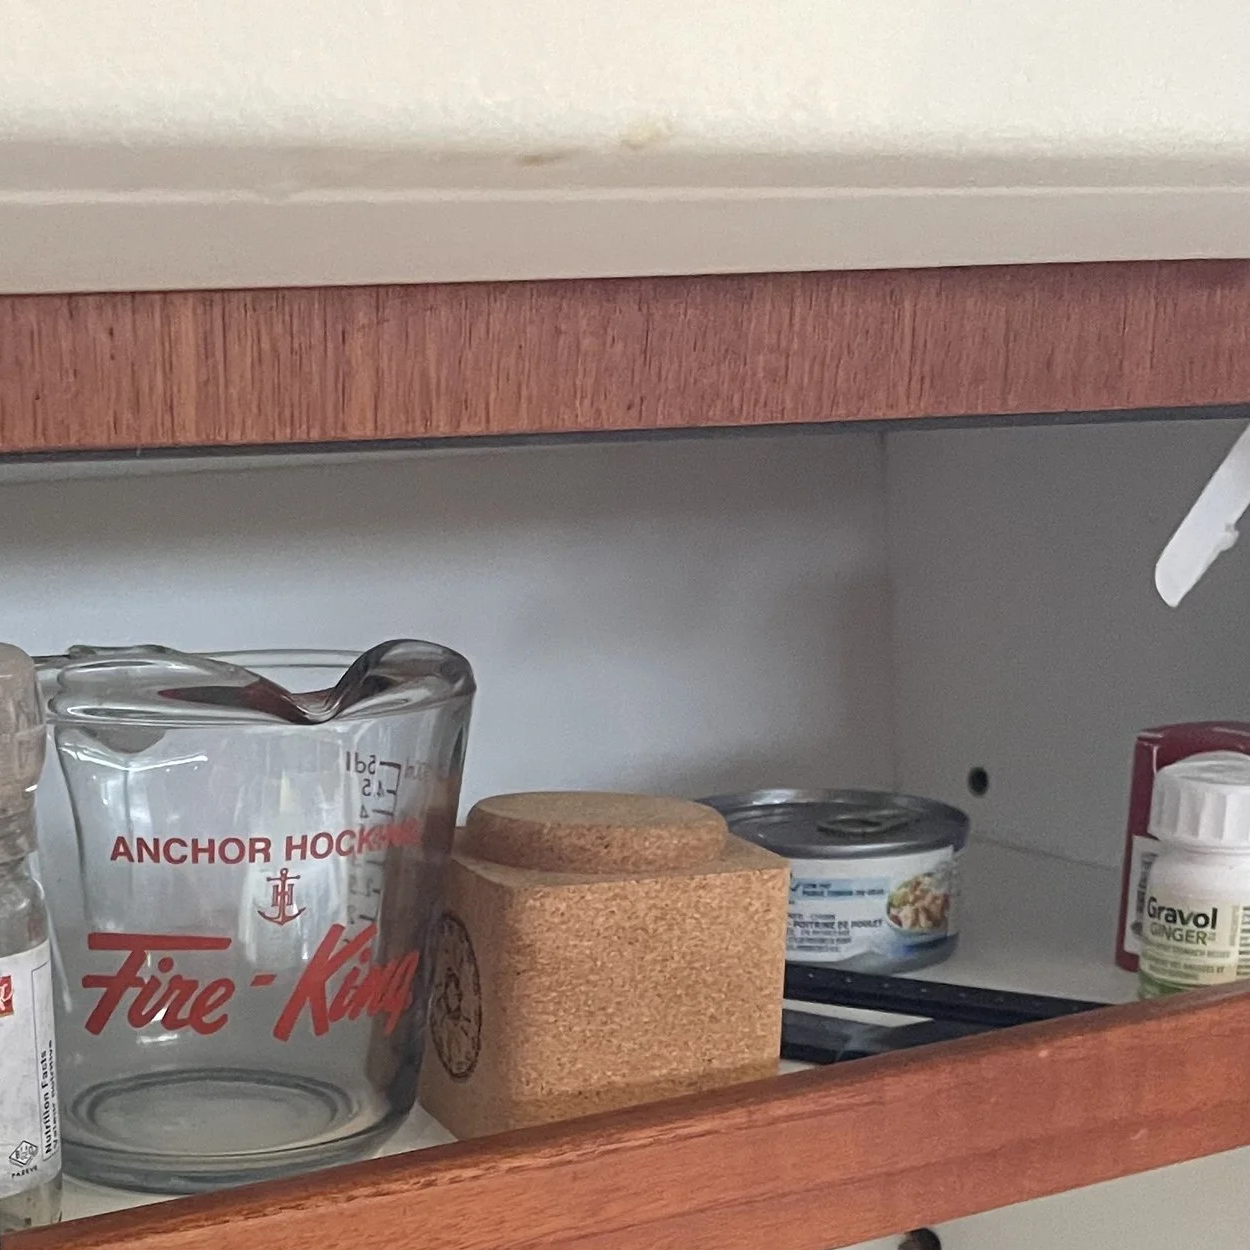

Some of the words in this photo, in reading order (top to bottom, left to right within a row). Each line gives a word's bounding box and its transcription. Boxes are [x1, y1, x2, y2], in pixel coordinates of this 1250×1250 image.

[110, 836, 271, 865] ANCHOR
[285, 818, 422, 861] HOCK
[1147, 896, 1218, 930] Gravol
[40, 1050, 50, 1089] Facts
